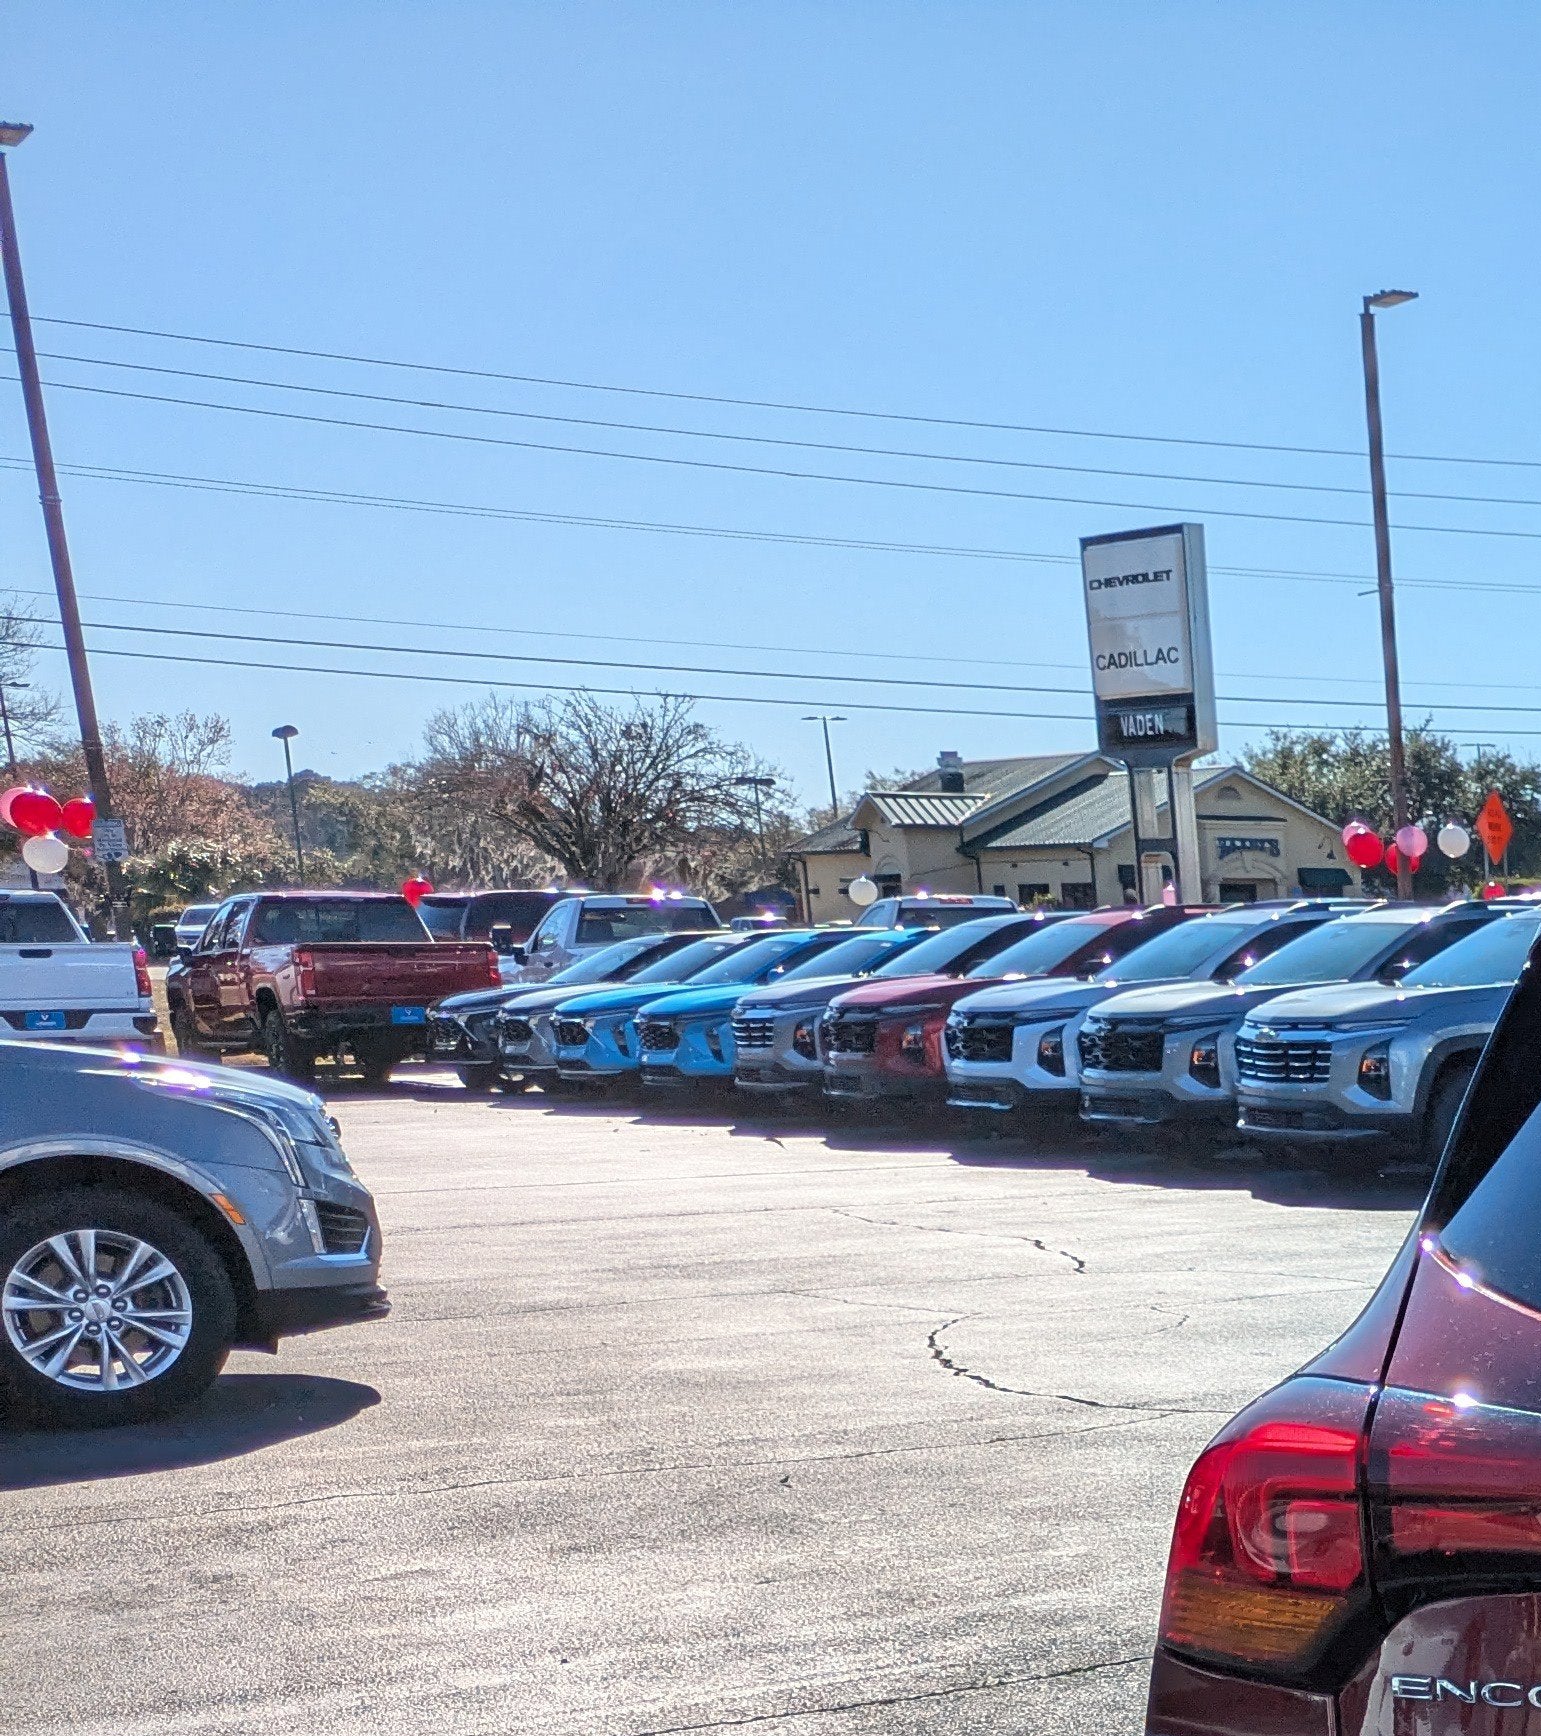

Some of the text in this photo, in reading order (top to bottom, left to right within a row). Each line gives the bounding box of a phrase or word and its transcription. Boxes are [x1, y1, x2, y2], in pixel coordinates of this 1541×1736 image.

[1089, 569, 1173, 591] CHEVROLET
[1095, 646, 1180, 671] CADILLAC
[1120, 713, 1165, 737] VADEN
